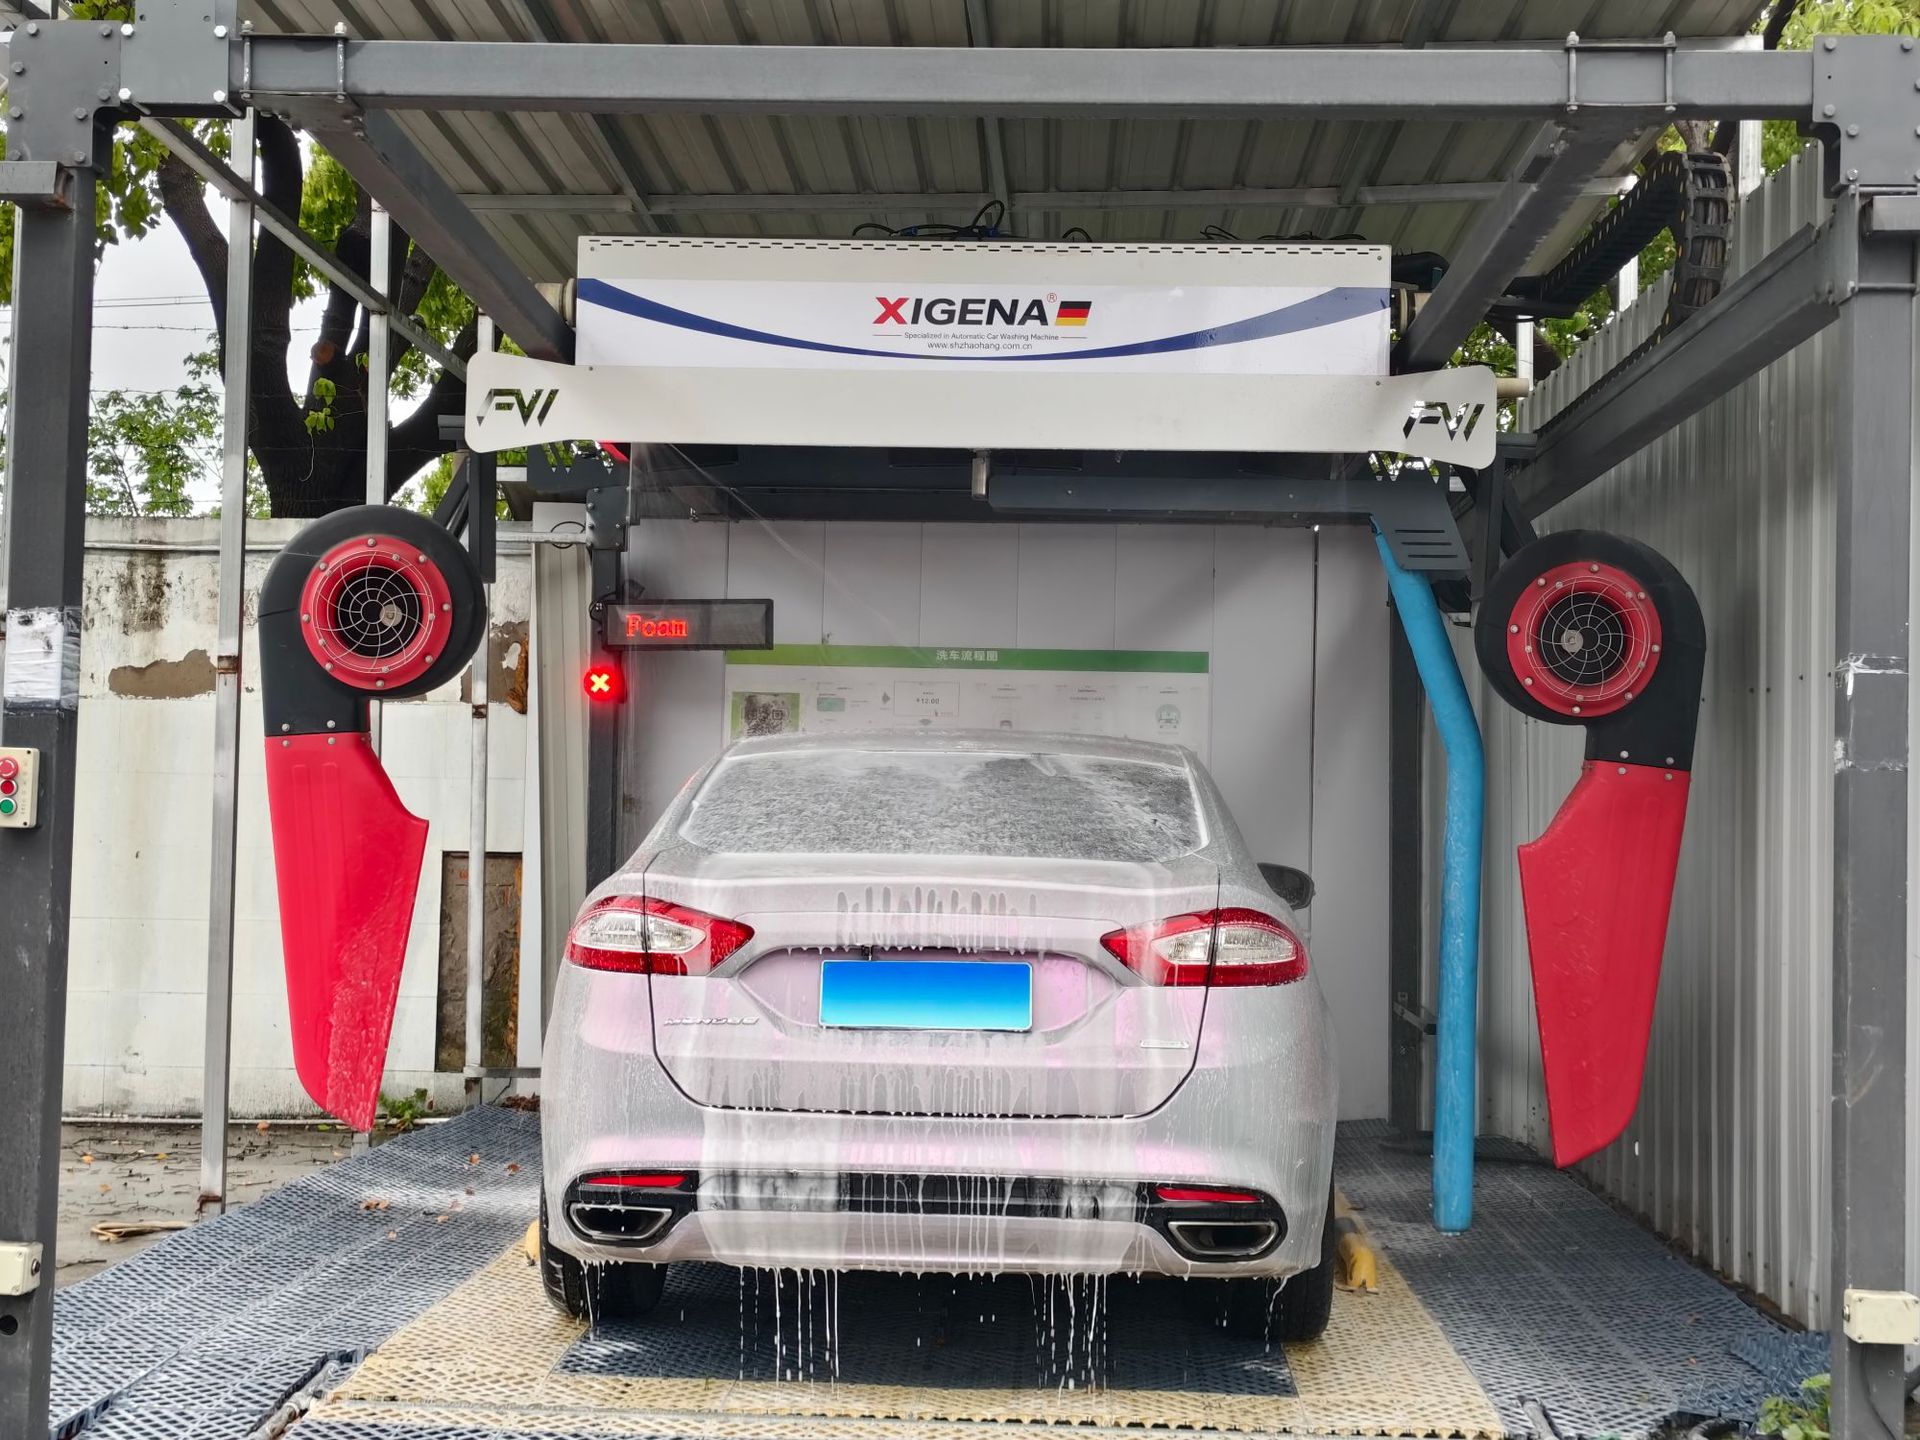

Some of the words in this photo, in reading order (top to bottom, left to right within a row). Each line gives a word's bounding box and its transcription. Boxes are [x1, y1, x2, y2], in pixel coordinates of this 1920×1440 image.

[904, 332, 942, 340] Specialized
[1000, 333, 1029, 342] Washing
[927, 342, 1032, 350] www.shzhaohang.com.cn
[626, 613, 688, 638] Foam
[936, 650, 998, 661] 洗车流程图
